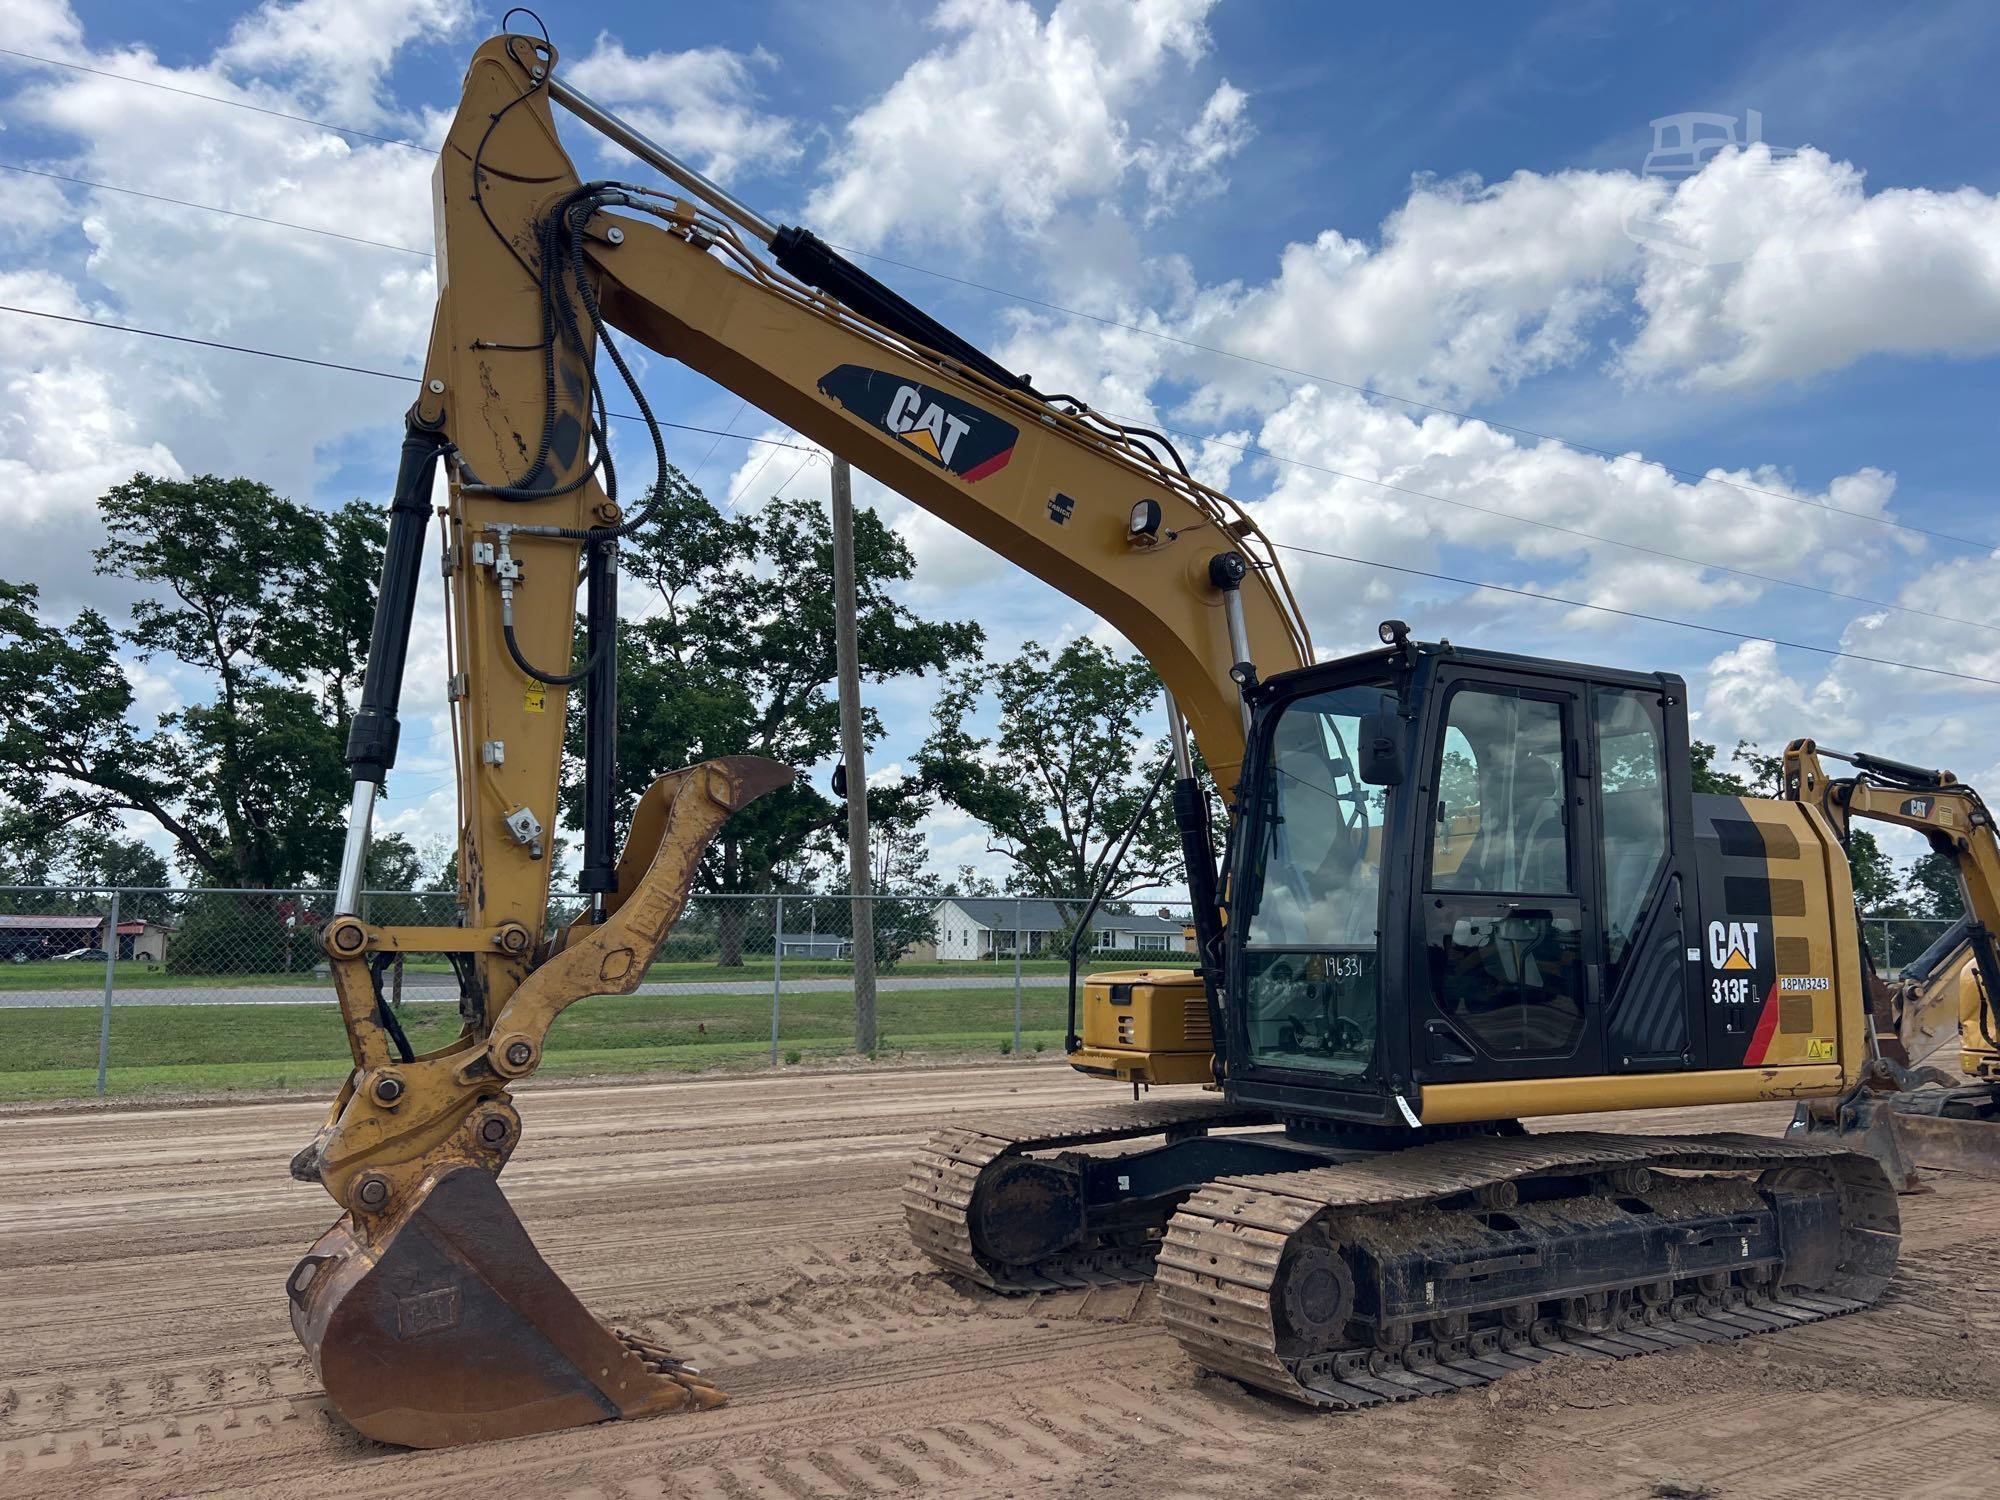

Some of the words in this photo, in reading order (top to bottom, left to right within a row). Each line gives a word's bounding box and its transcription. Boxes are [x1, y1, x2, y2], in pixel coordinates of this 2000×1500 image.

[886, 386, 970, 465] CAT
[1911, 800, 1926, 818] CAT
[1708, 920, 1758, 970] CAT
[1325, 957, 1362, 976] 196331
[1712, 979, 1748, 1004] 313F
[1781, 978, 1828, 990] 18PM3243
